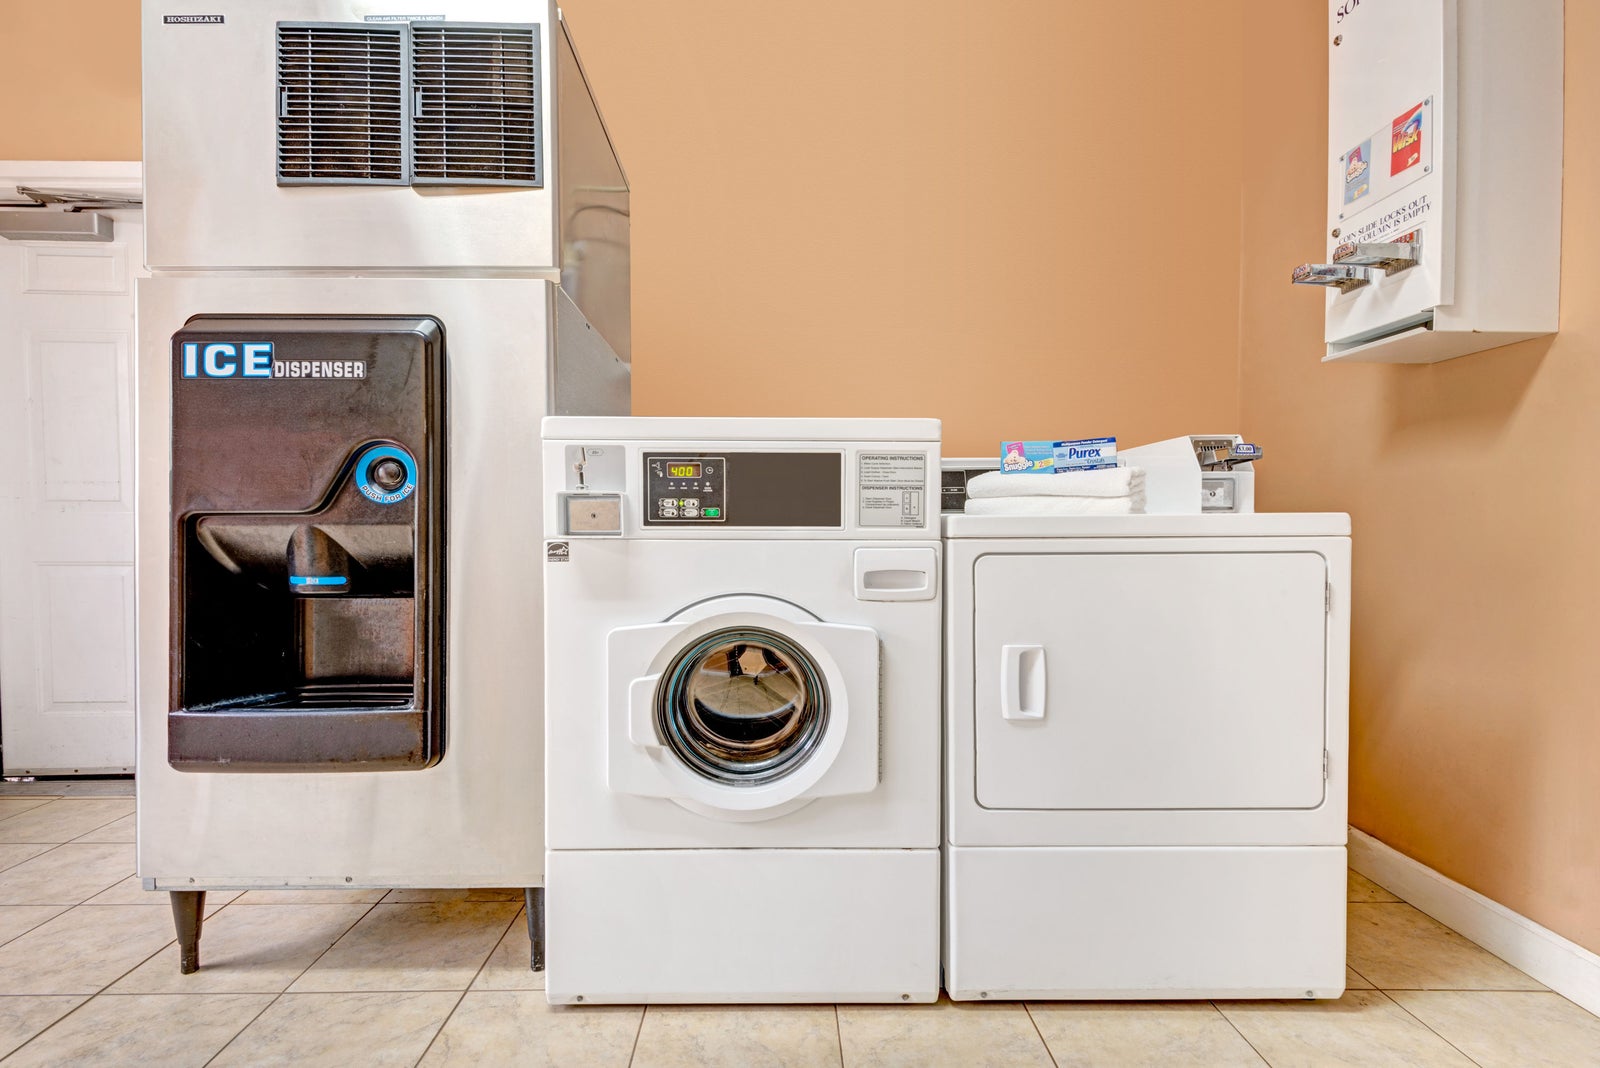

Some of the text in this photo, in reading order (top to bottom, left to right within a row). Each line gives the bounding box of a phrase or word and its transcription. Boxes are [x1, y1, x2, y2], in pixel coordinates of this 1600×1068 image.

[1393, 129, 1418, 154] Wisk
[1339, 231, 1357, 246] COIN
[1358, 220, 1378, 236] SLIDE
[1379, 205, 1407, 225] LOCKS
[1408, 194, 1428, 210] OUT
[1358, 222, 1391, 244] COLUMN
[1393, 217, 1401, 227] IS
[1403, 201, 1432, 222] EMPTY
[183, 342, 365, 379] ICE DISPENSER
[1068, 447, 1101, 460] Purex
[671, 466, 693, 477] 400
[1003, 459, 1034, 472] Snuggle
[361, 483, 413, 502] PUSH FOR ICE
